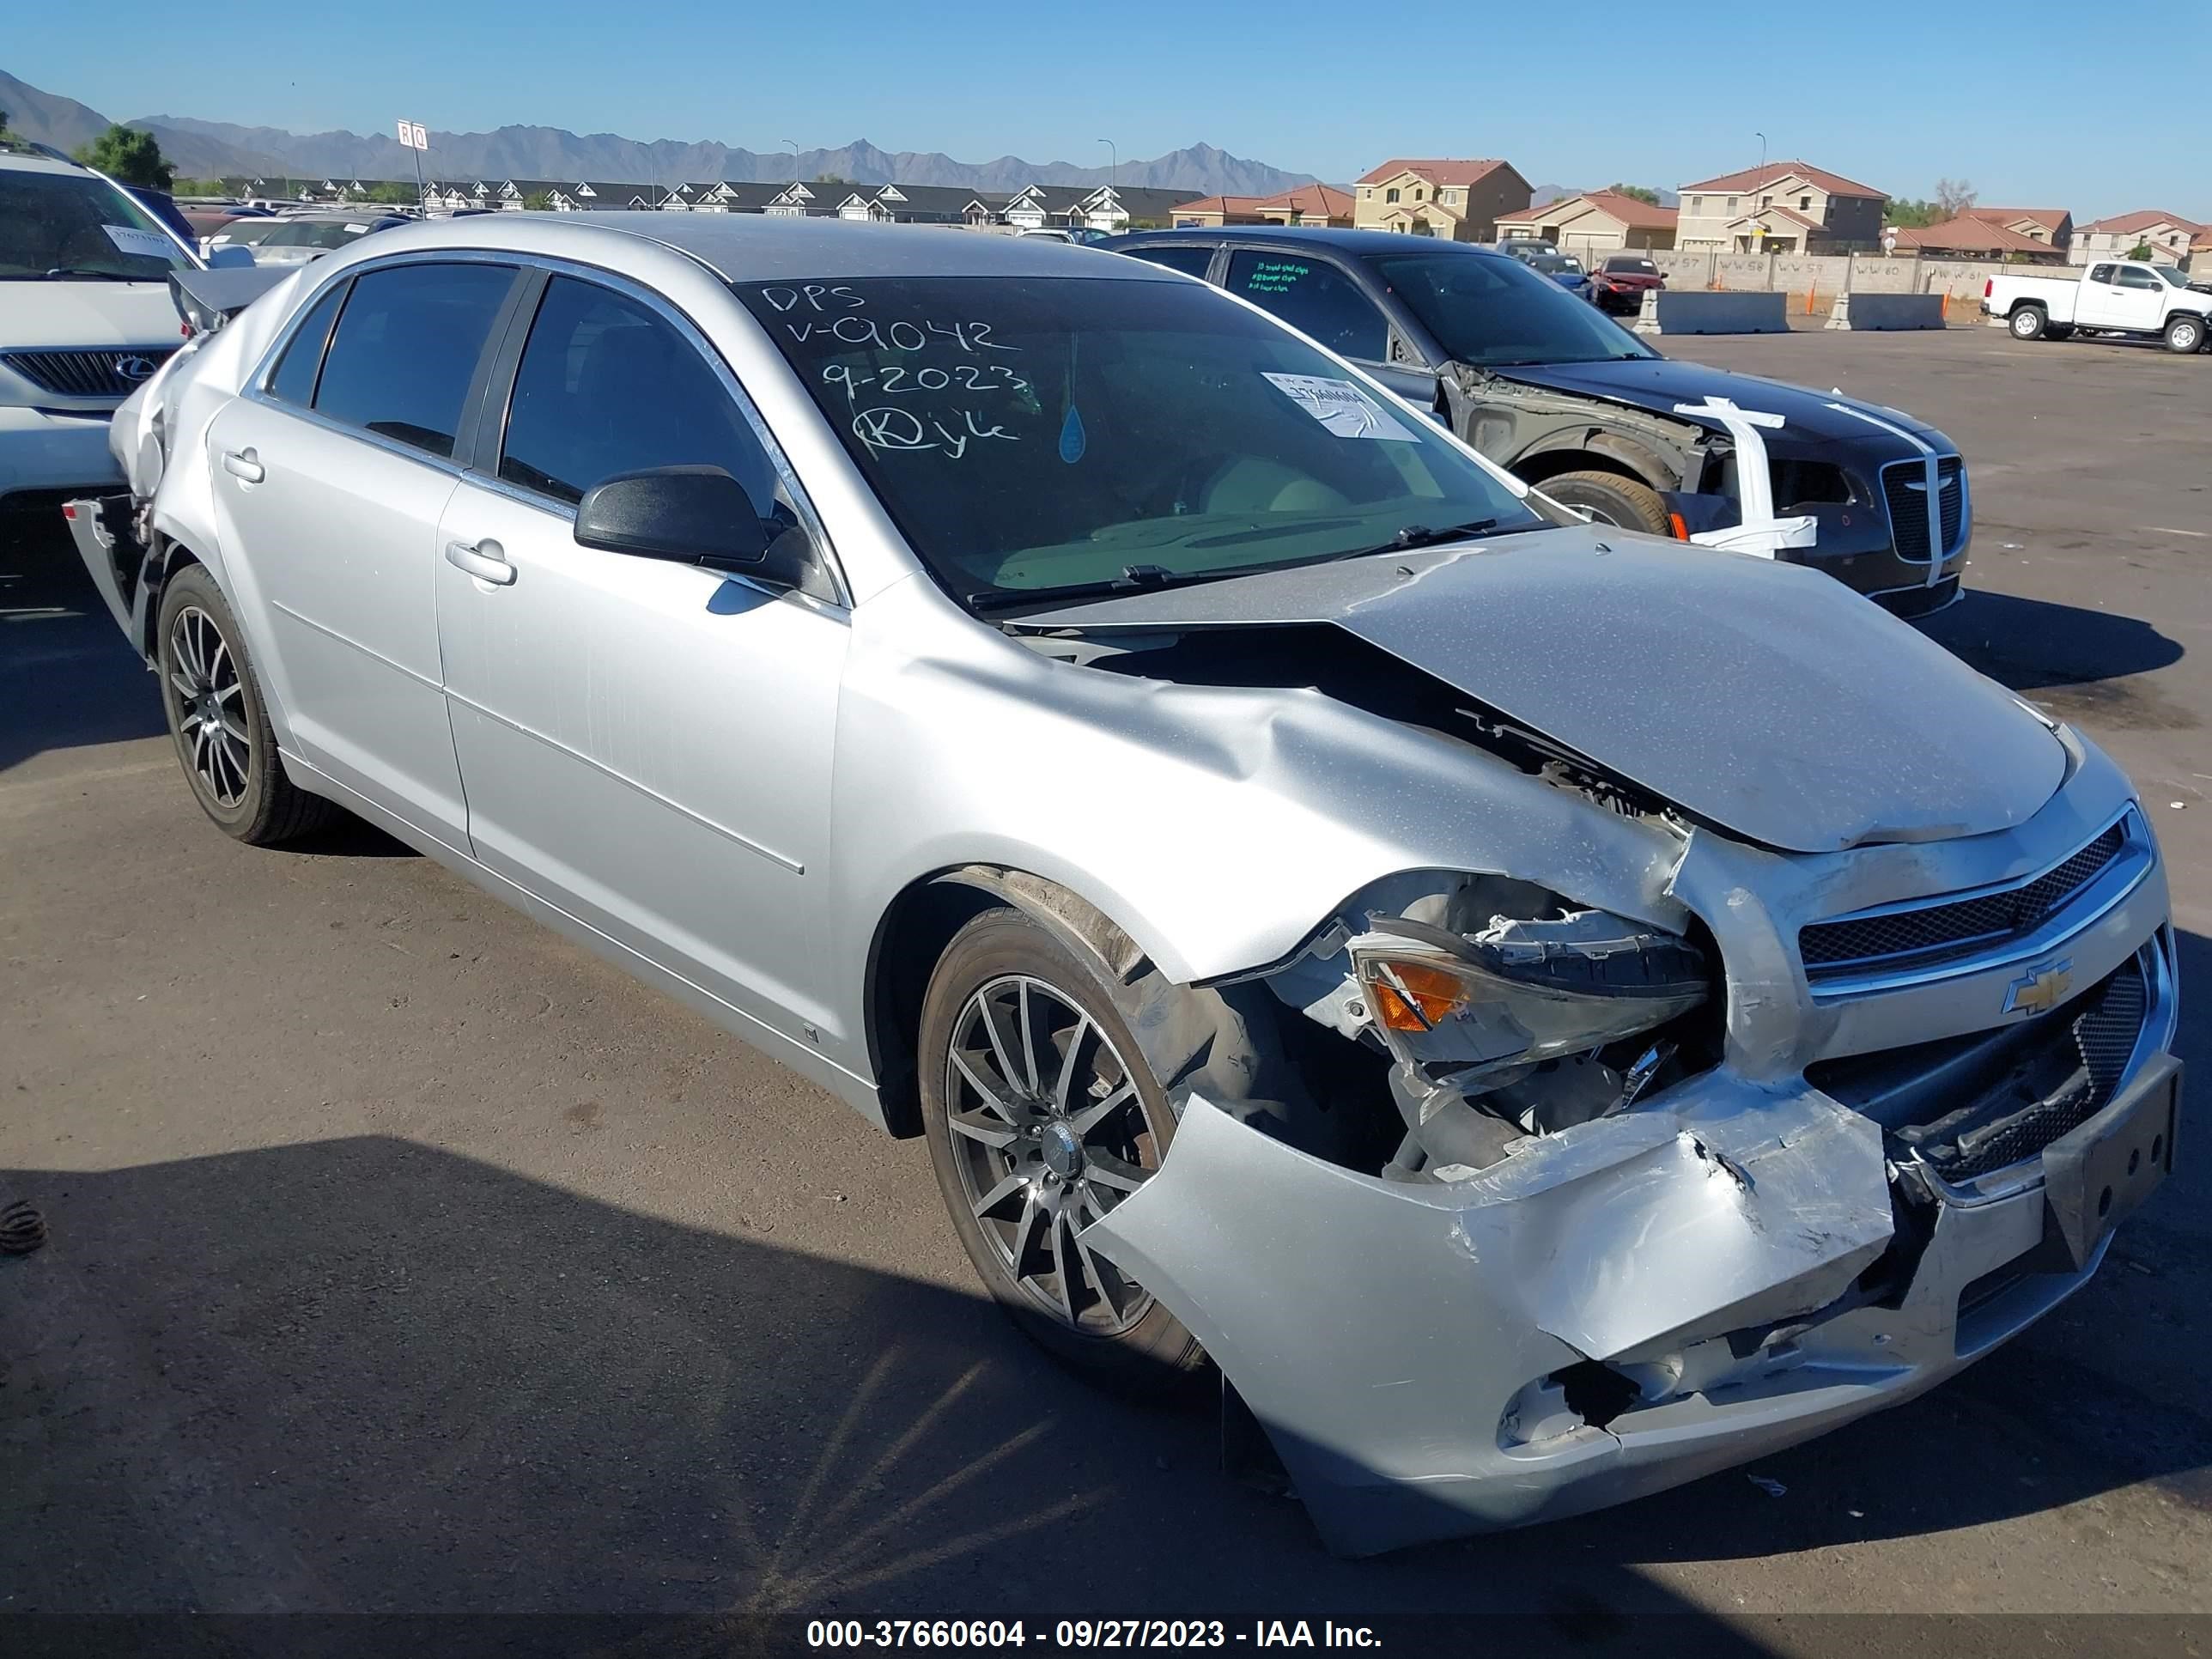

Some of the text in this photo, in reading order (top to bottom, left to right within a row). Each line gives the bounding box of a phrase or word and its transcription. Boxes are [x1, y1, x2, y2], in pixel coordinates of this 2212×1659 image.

[401, 125, 410, 144] R
[1682, 258, 1699, 268] 57
[1747, 261, 1764, 272] 58
[762, 284, 866, 312] DPS
